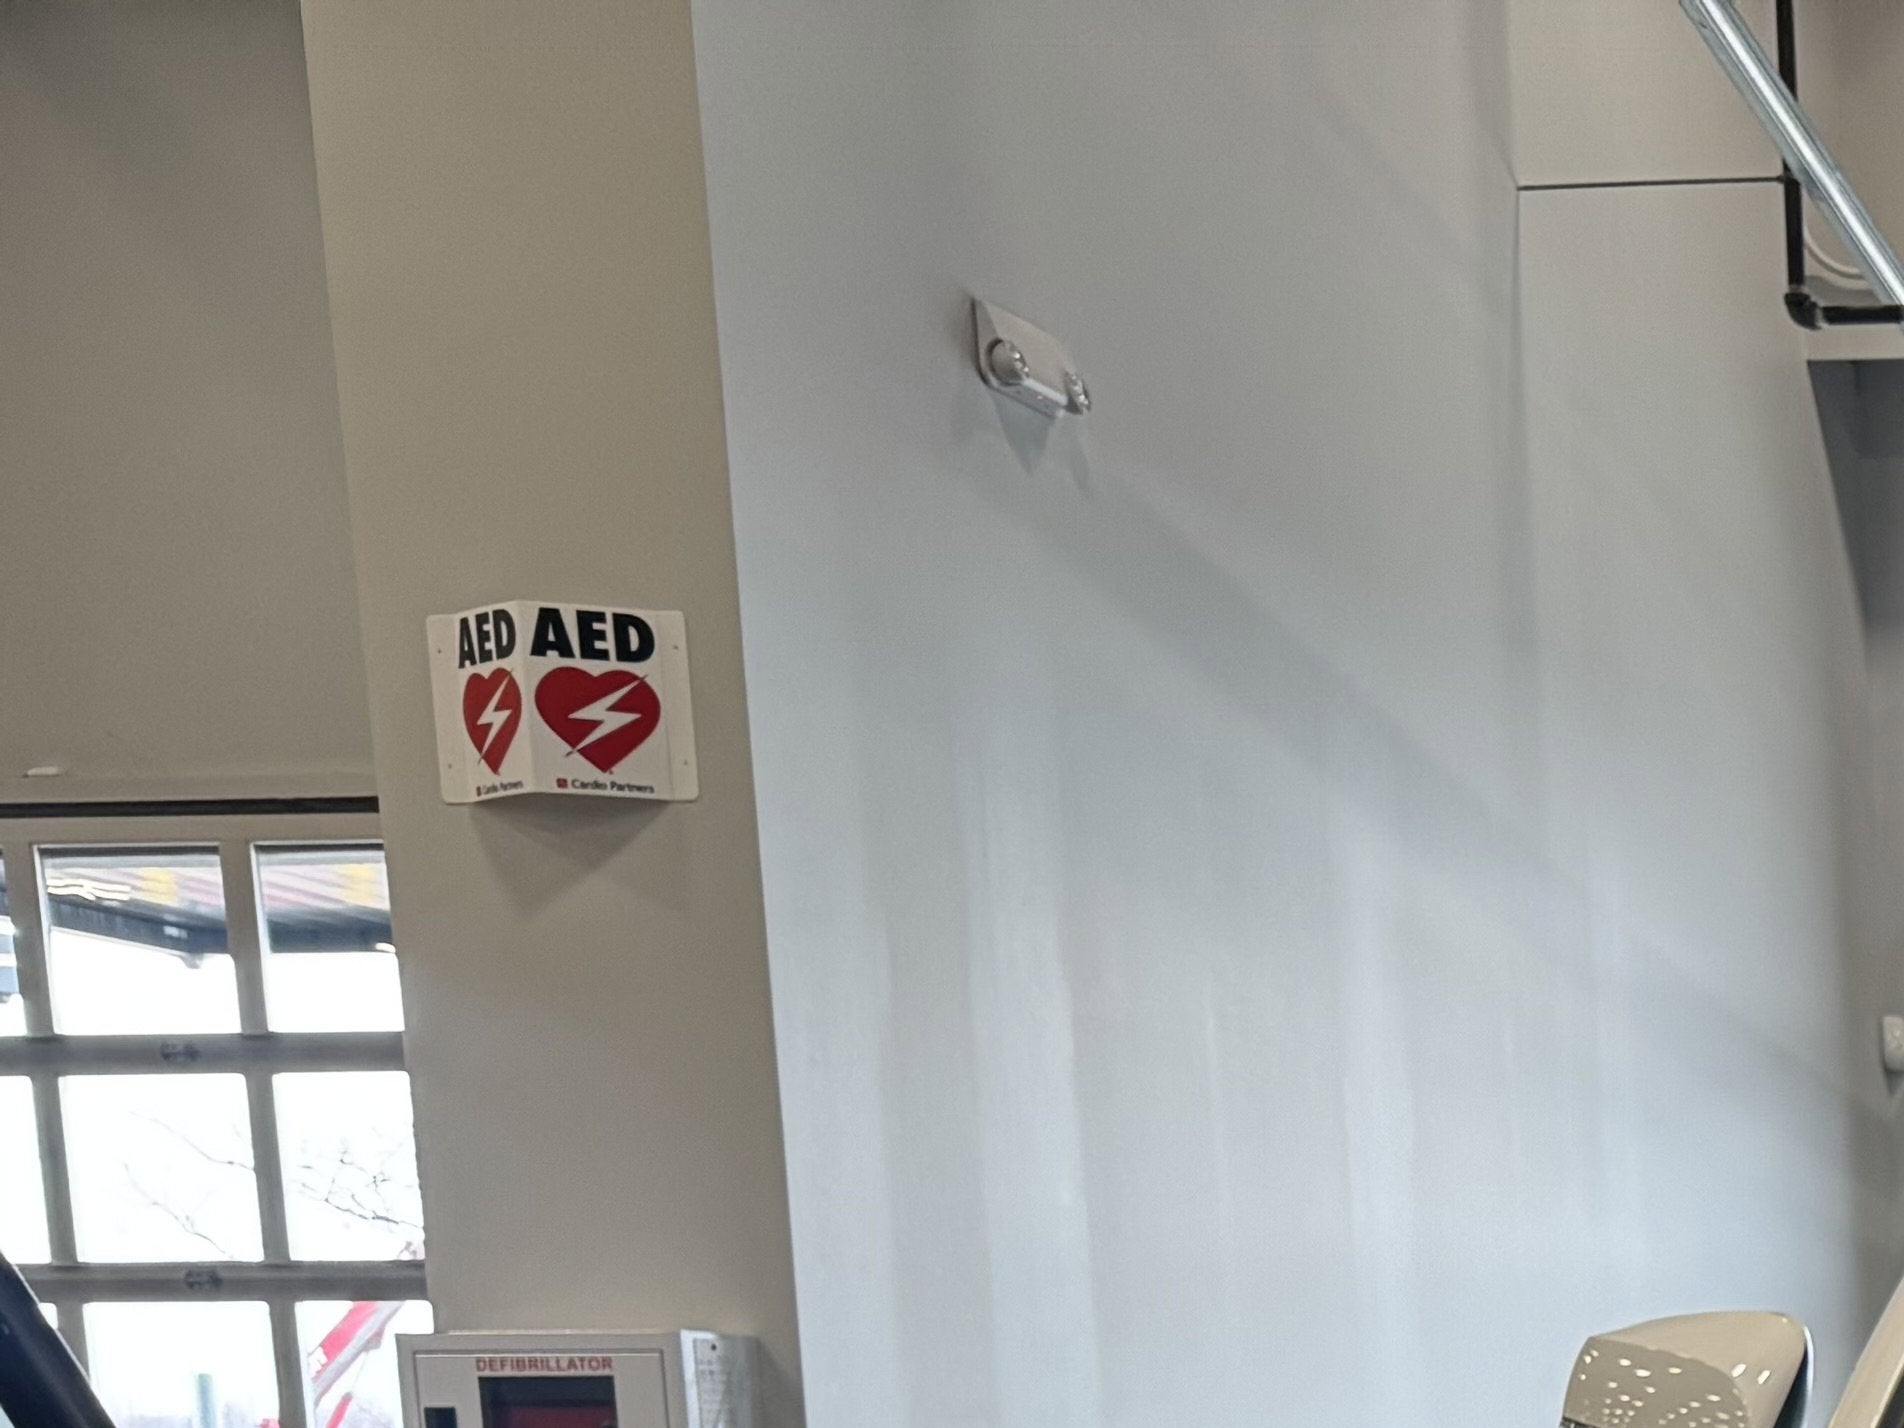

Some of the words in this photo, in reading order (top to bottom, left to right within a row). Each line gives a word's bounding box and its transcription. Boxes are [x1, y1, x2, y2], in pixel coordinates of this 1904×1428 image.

[458, 608, 517, 669] AED
[529, 608, 655, 663] AED
[571, 779, 607, 791] Cardio
[610, 781, 655, 794] Partners
[475, 1356, 612, 1372] DEFIBRILLATOR
